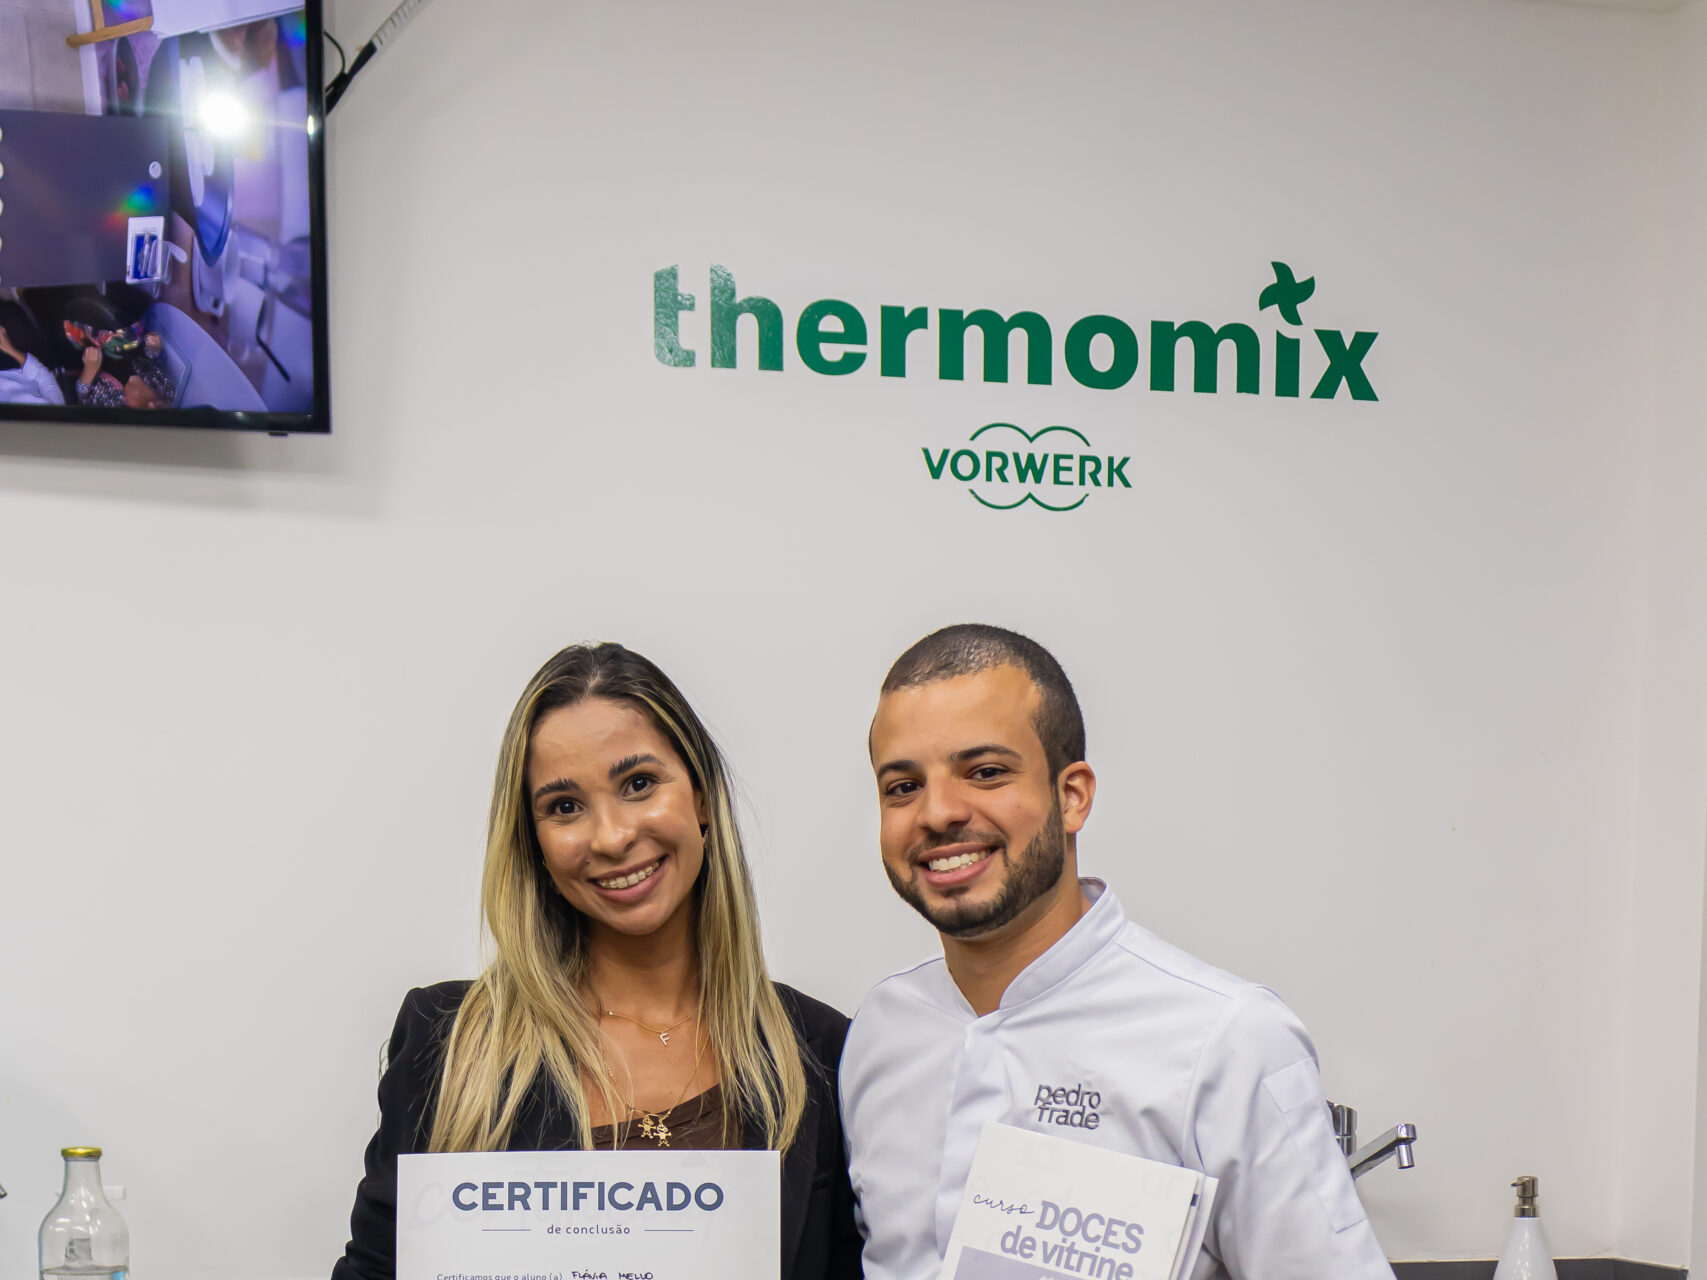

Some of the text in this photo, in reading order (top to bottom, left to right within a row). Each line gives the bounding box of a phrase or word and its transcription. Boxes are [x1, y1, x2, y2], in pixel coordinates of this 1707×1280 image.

[653, 260, 1380, 402] thermomix
[921, 447, 1133, 489] VORWERK
[1034, 1083, 1101, 1109] pedro
[1037, 1101, 1100, 1130] frade
[452, 1181, 724, 1212] CERTIFICADO
[546, 1224, 631, 1235] de conclusão
[973, 1194, 1145, 1254] curso DOCES
[1001, 1225, 1037, 1259] de
[618, 1271, 654, 1280] MELLO
